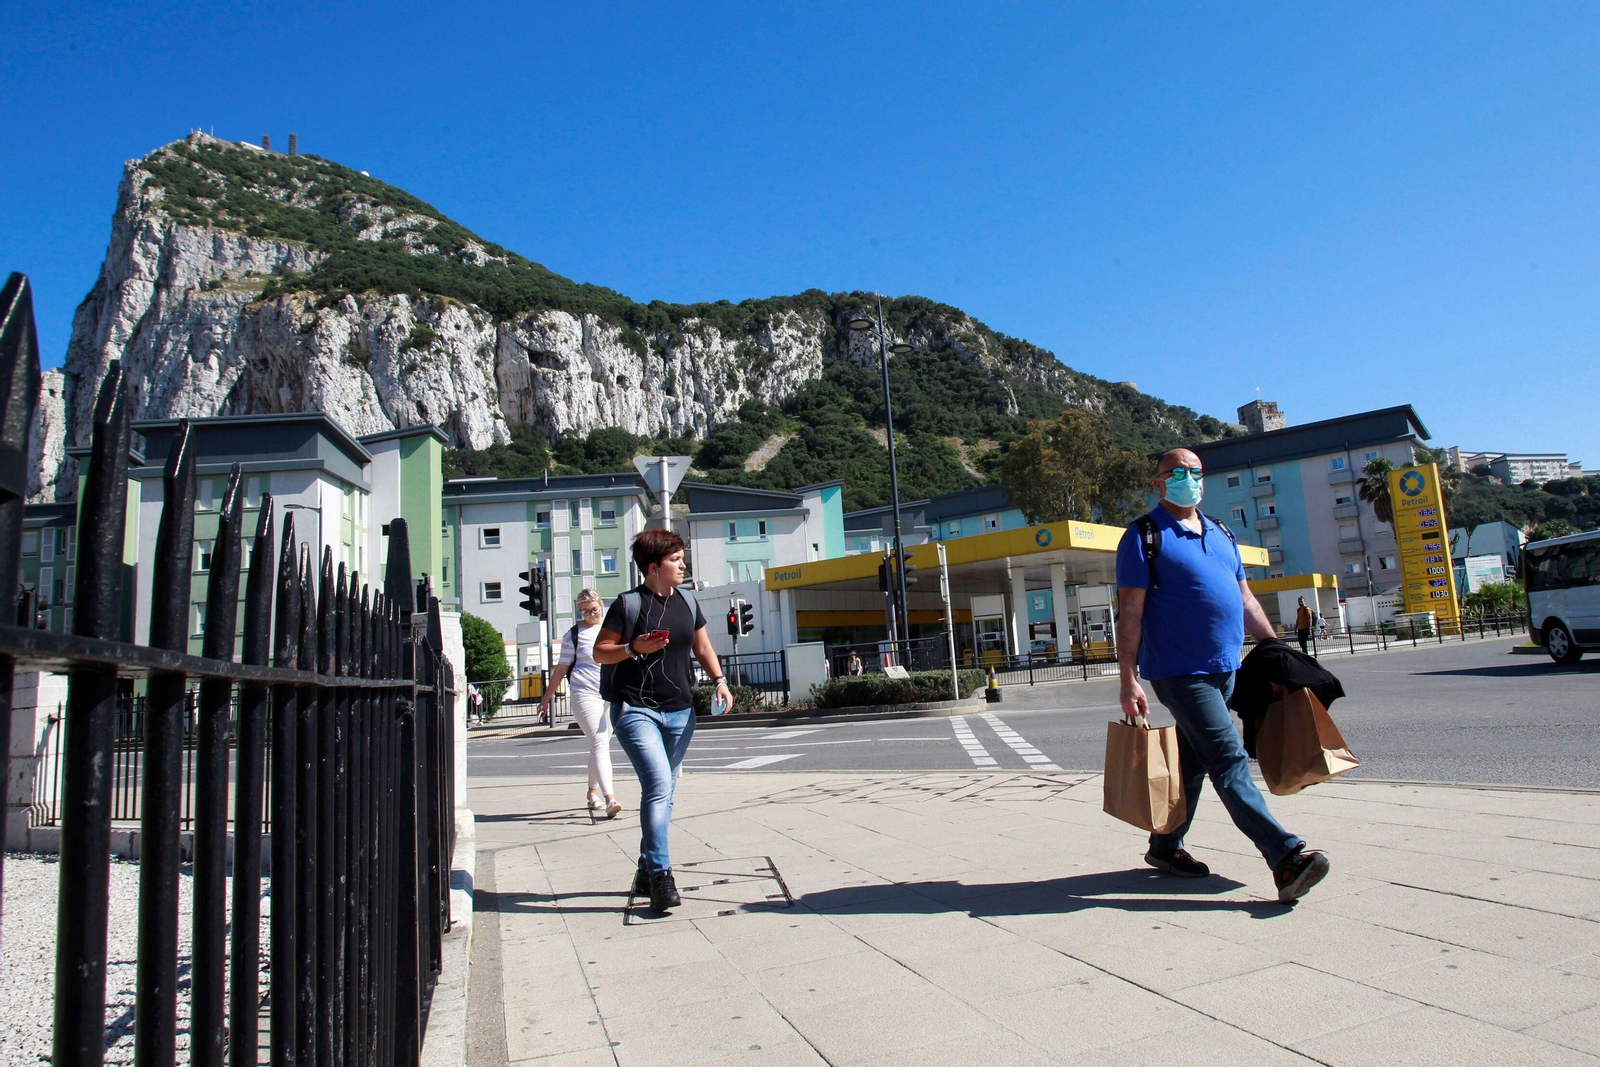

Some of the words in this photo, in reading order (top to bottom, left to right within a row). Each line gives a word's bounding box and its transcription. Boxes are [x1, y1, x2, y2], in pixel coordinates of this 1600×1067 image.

[1402, 496, 1428, 507] Petroil
[1075, 526, 1095, 540] Petroil
[774, 568, 802, 582] Petroil
